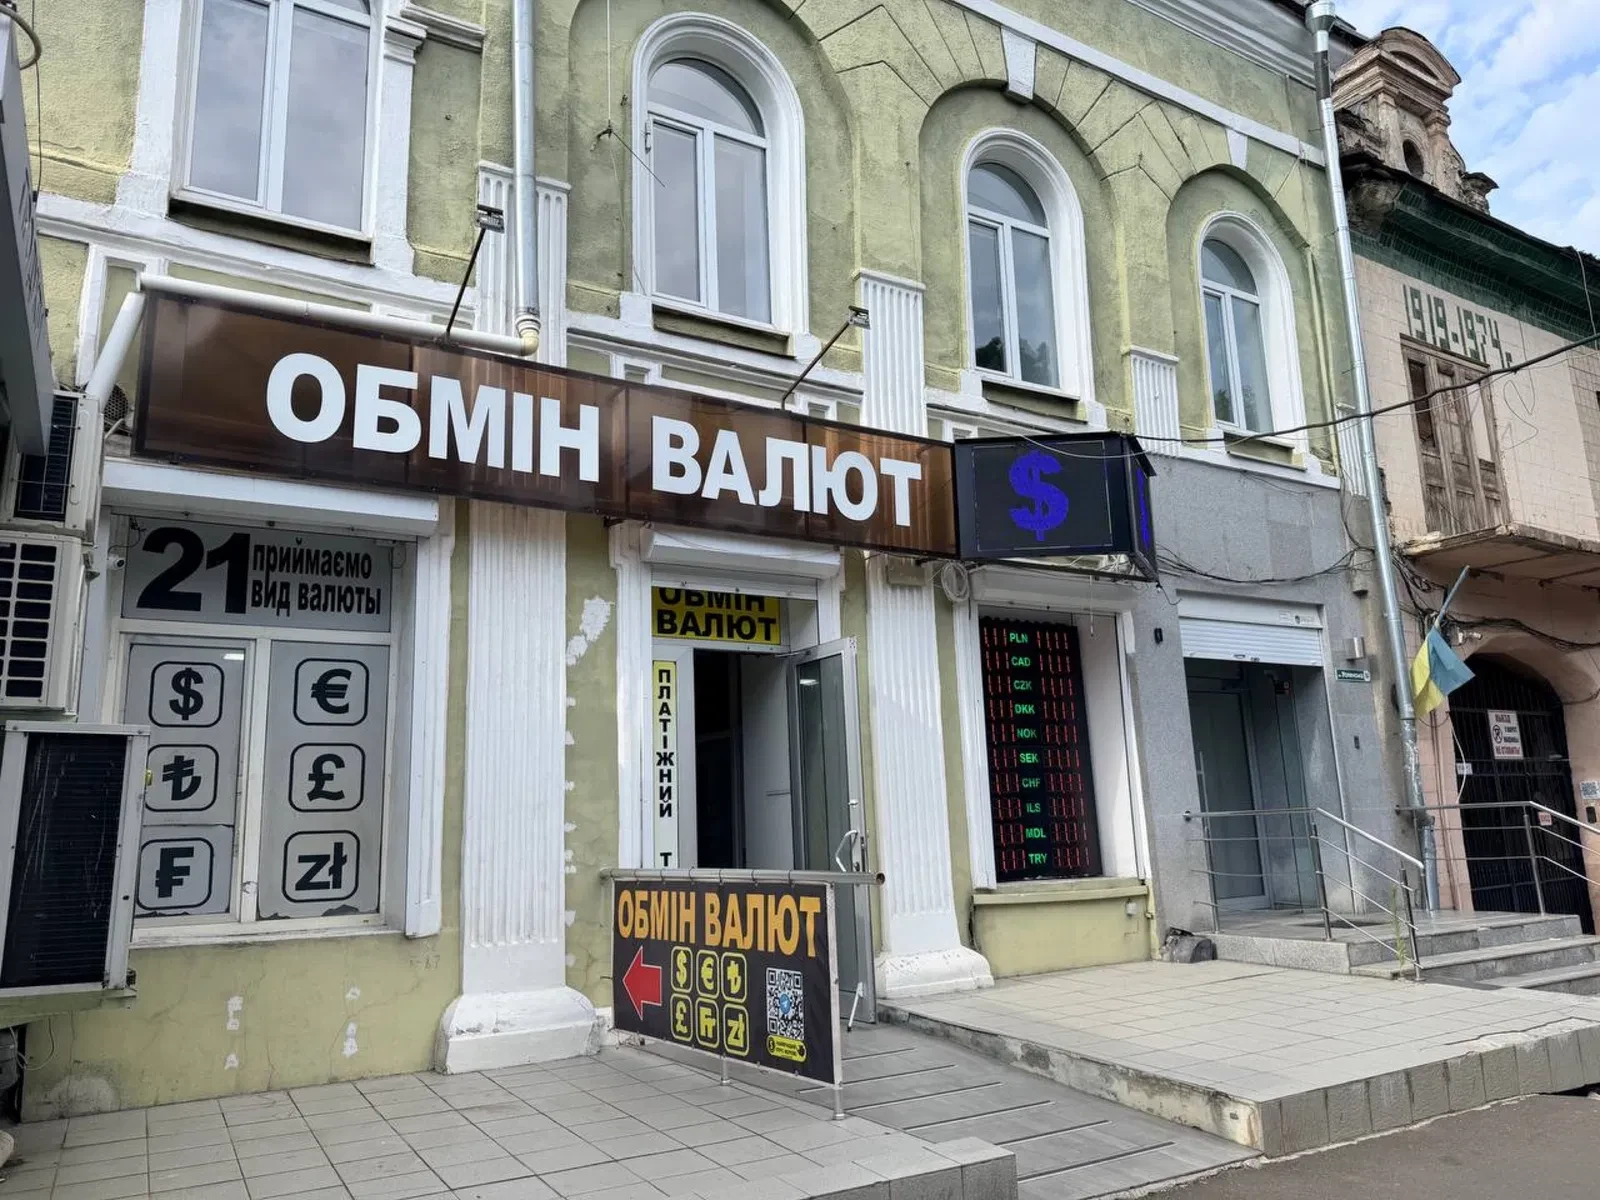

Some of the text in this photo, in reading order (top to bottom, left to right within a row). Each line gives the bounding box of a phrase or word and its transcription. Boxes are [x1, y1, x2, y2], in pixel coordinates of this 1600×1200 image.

[266, 352, 922, 527] ОБМІН ВАЛЮТ
[136, 526, 251, 614] 21
[252, 537, 373, 588] приймаємо
[250, 578, 382, 617] вид валюты
[656, 608, 777, 641] ВАЛЮТ
[1009, 631, 1029, 644] PLN
[1011, 655, 1031, 667] CAD
[311, 668, 352, 715] €
[1014, 703, 1036, 715] DKK
[656, 668, 675, 819] ПЛАТІЖНИЙ
[1016, 727, 1038, 739] NOK
[1019, 752, 1039, 764] SEK
[307, 753, 345, 802] £
[1021, 777, 1041, 789] CHF
[1026, 802, 1042, 813] ILS
[1025, 827, 1047, 839] MDL
[1028, 852, 1048, 865] TRY
[618, 889, 821, 958] ОБМІН ВАЛЮТ
